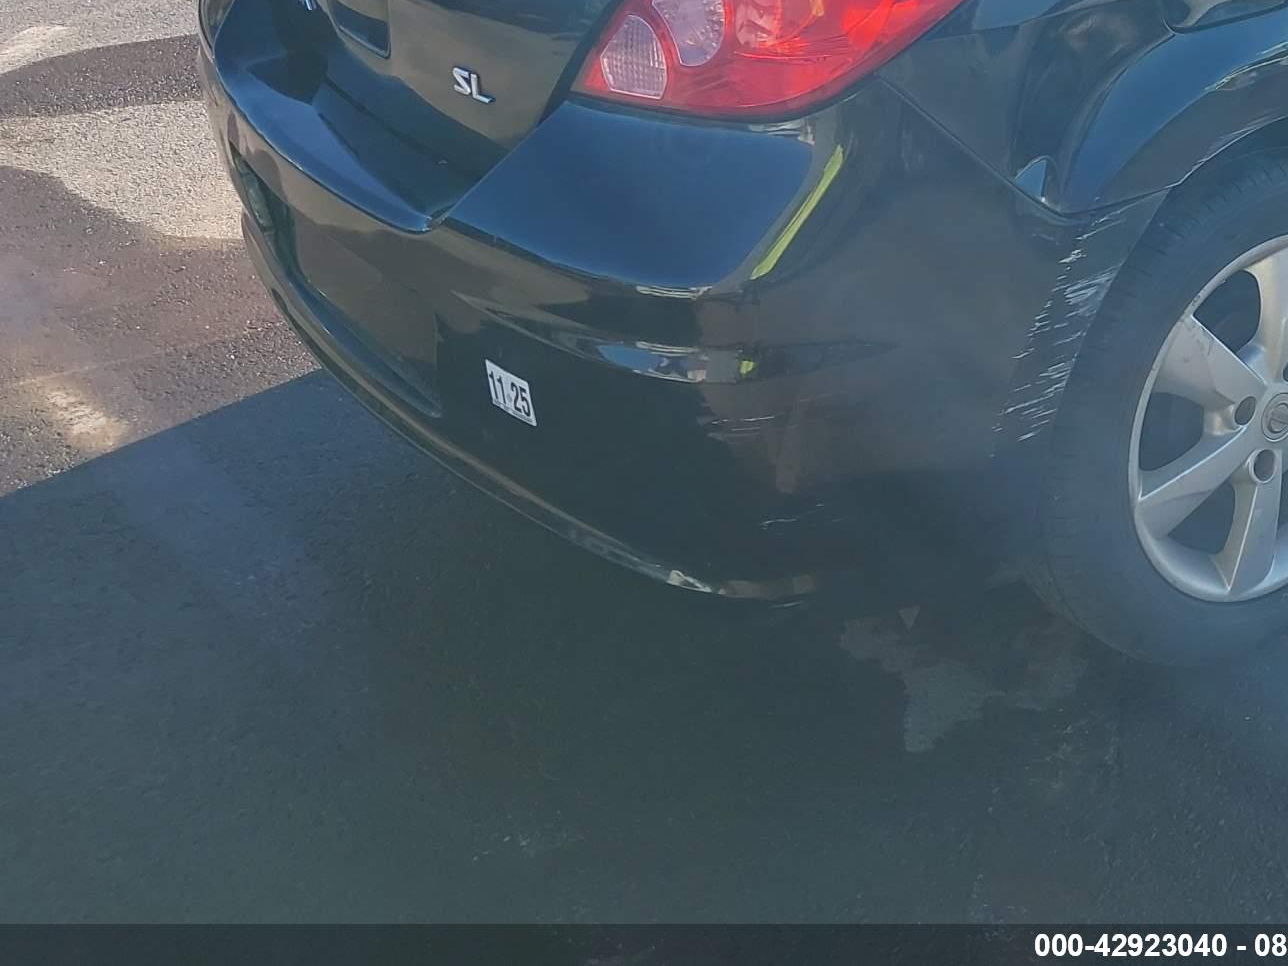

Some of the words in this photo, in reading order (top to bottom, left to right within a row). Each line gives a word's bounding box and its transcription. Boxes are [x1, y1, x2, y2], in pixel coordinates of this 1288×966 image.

[452, 66, 493, 104] SL
[488, 370, 507, 404] 11
[510, 381, 532, 418] 25
